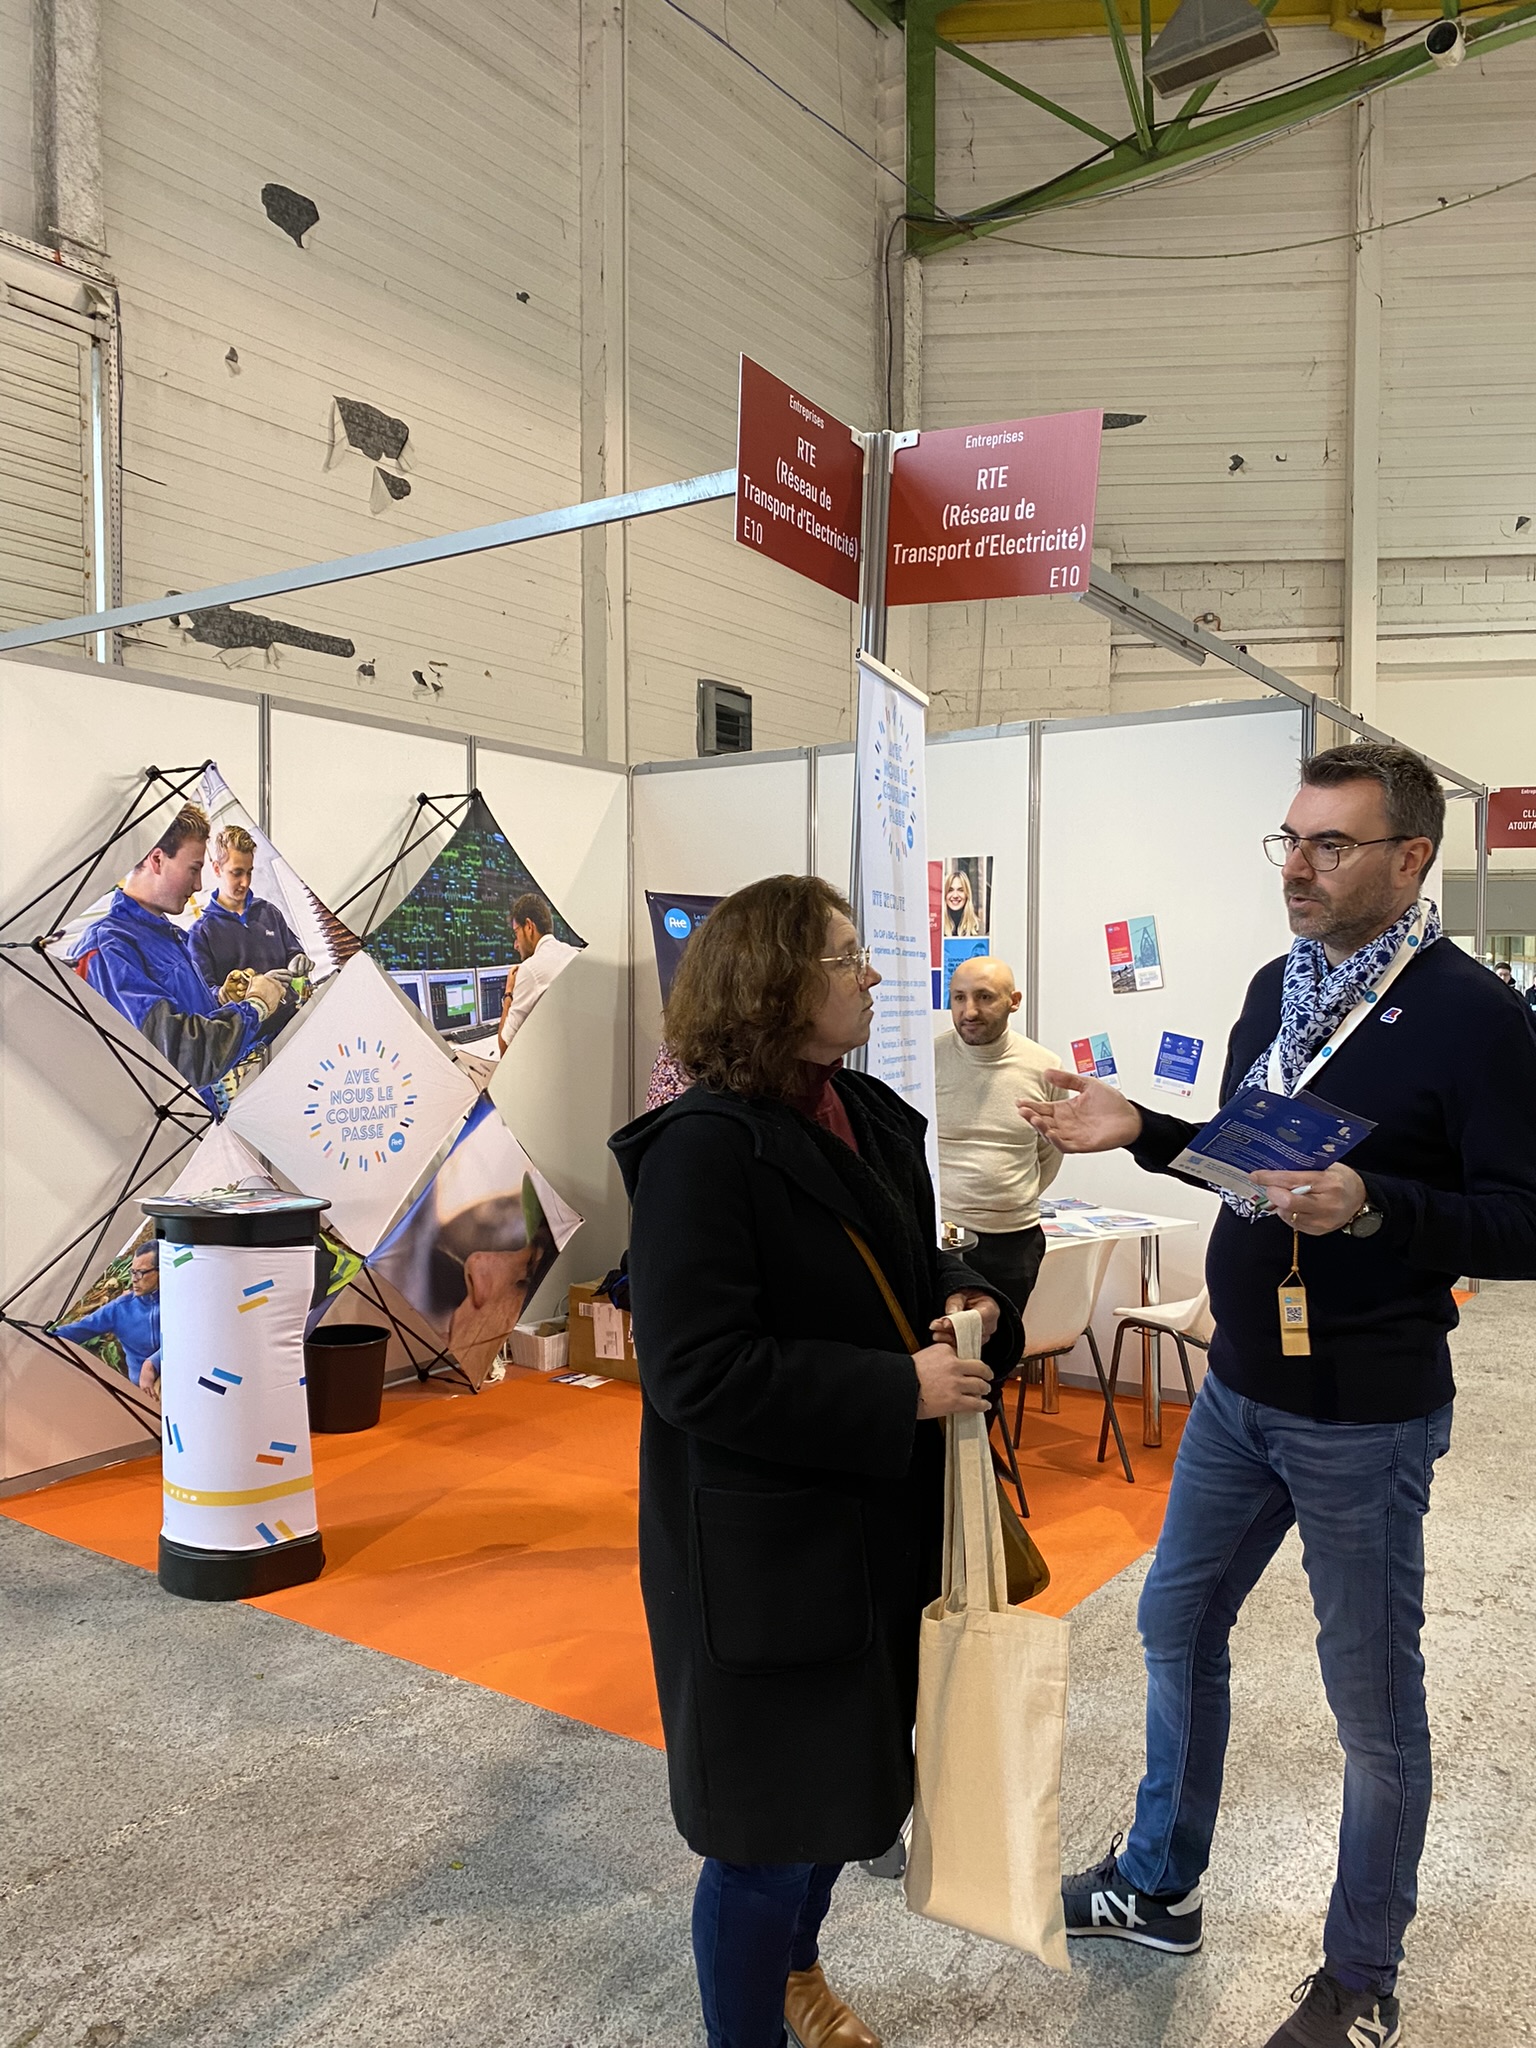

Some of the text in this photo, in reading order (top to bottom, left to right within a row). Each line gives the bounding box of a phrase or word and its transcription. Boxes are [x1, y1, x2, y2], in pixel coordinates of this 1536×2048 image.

[789, 394, 825, 429] Entreprises
[797, 435, 817, 468] RTE
[965, 430, 1024, 449] Entreprises
[776, 457, 832, 512] (Réseau de
[976, 465, 1009, 491] RTE
[743, 474, 859, 563] Transport d'Electricité)
[942, 497, 1036, 530] (Réseau de
[744, 516, 763, 545] E10
[893, 523, 1087, 567] Transport d'Electricité)
[1049, 565, 1080, 588] E10
[344, 1068, 380, 1085] AVEC
[330, 1086, 394, 1105] NOUS LE
[326, 1104, 398, 1124] COURANT
[341, 1124, 384, 1142] PASSE
[1091, 1890, 1147, 1928] AX
